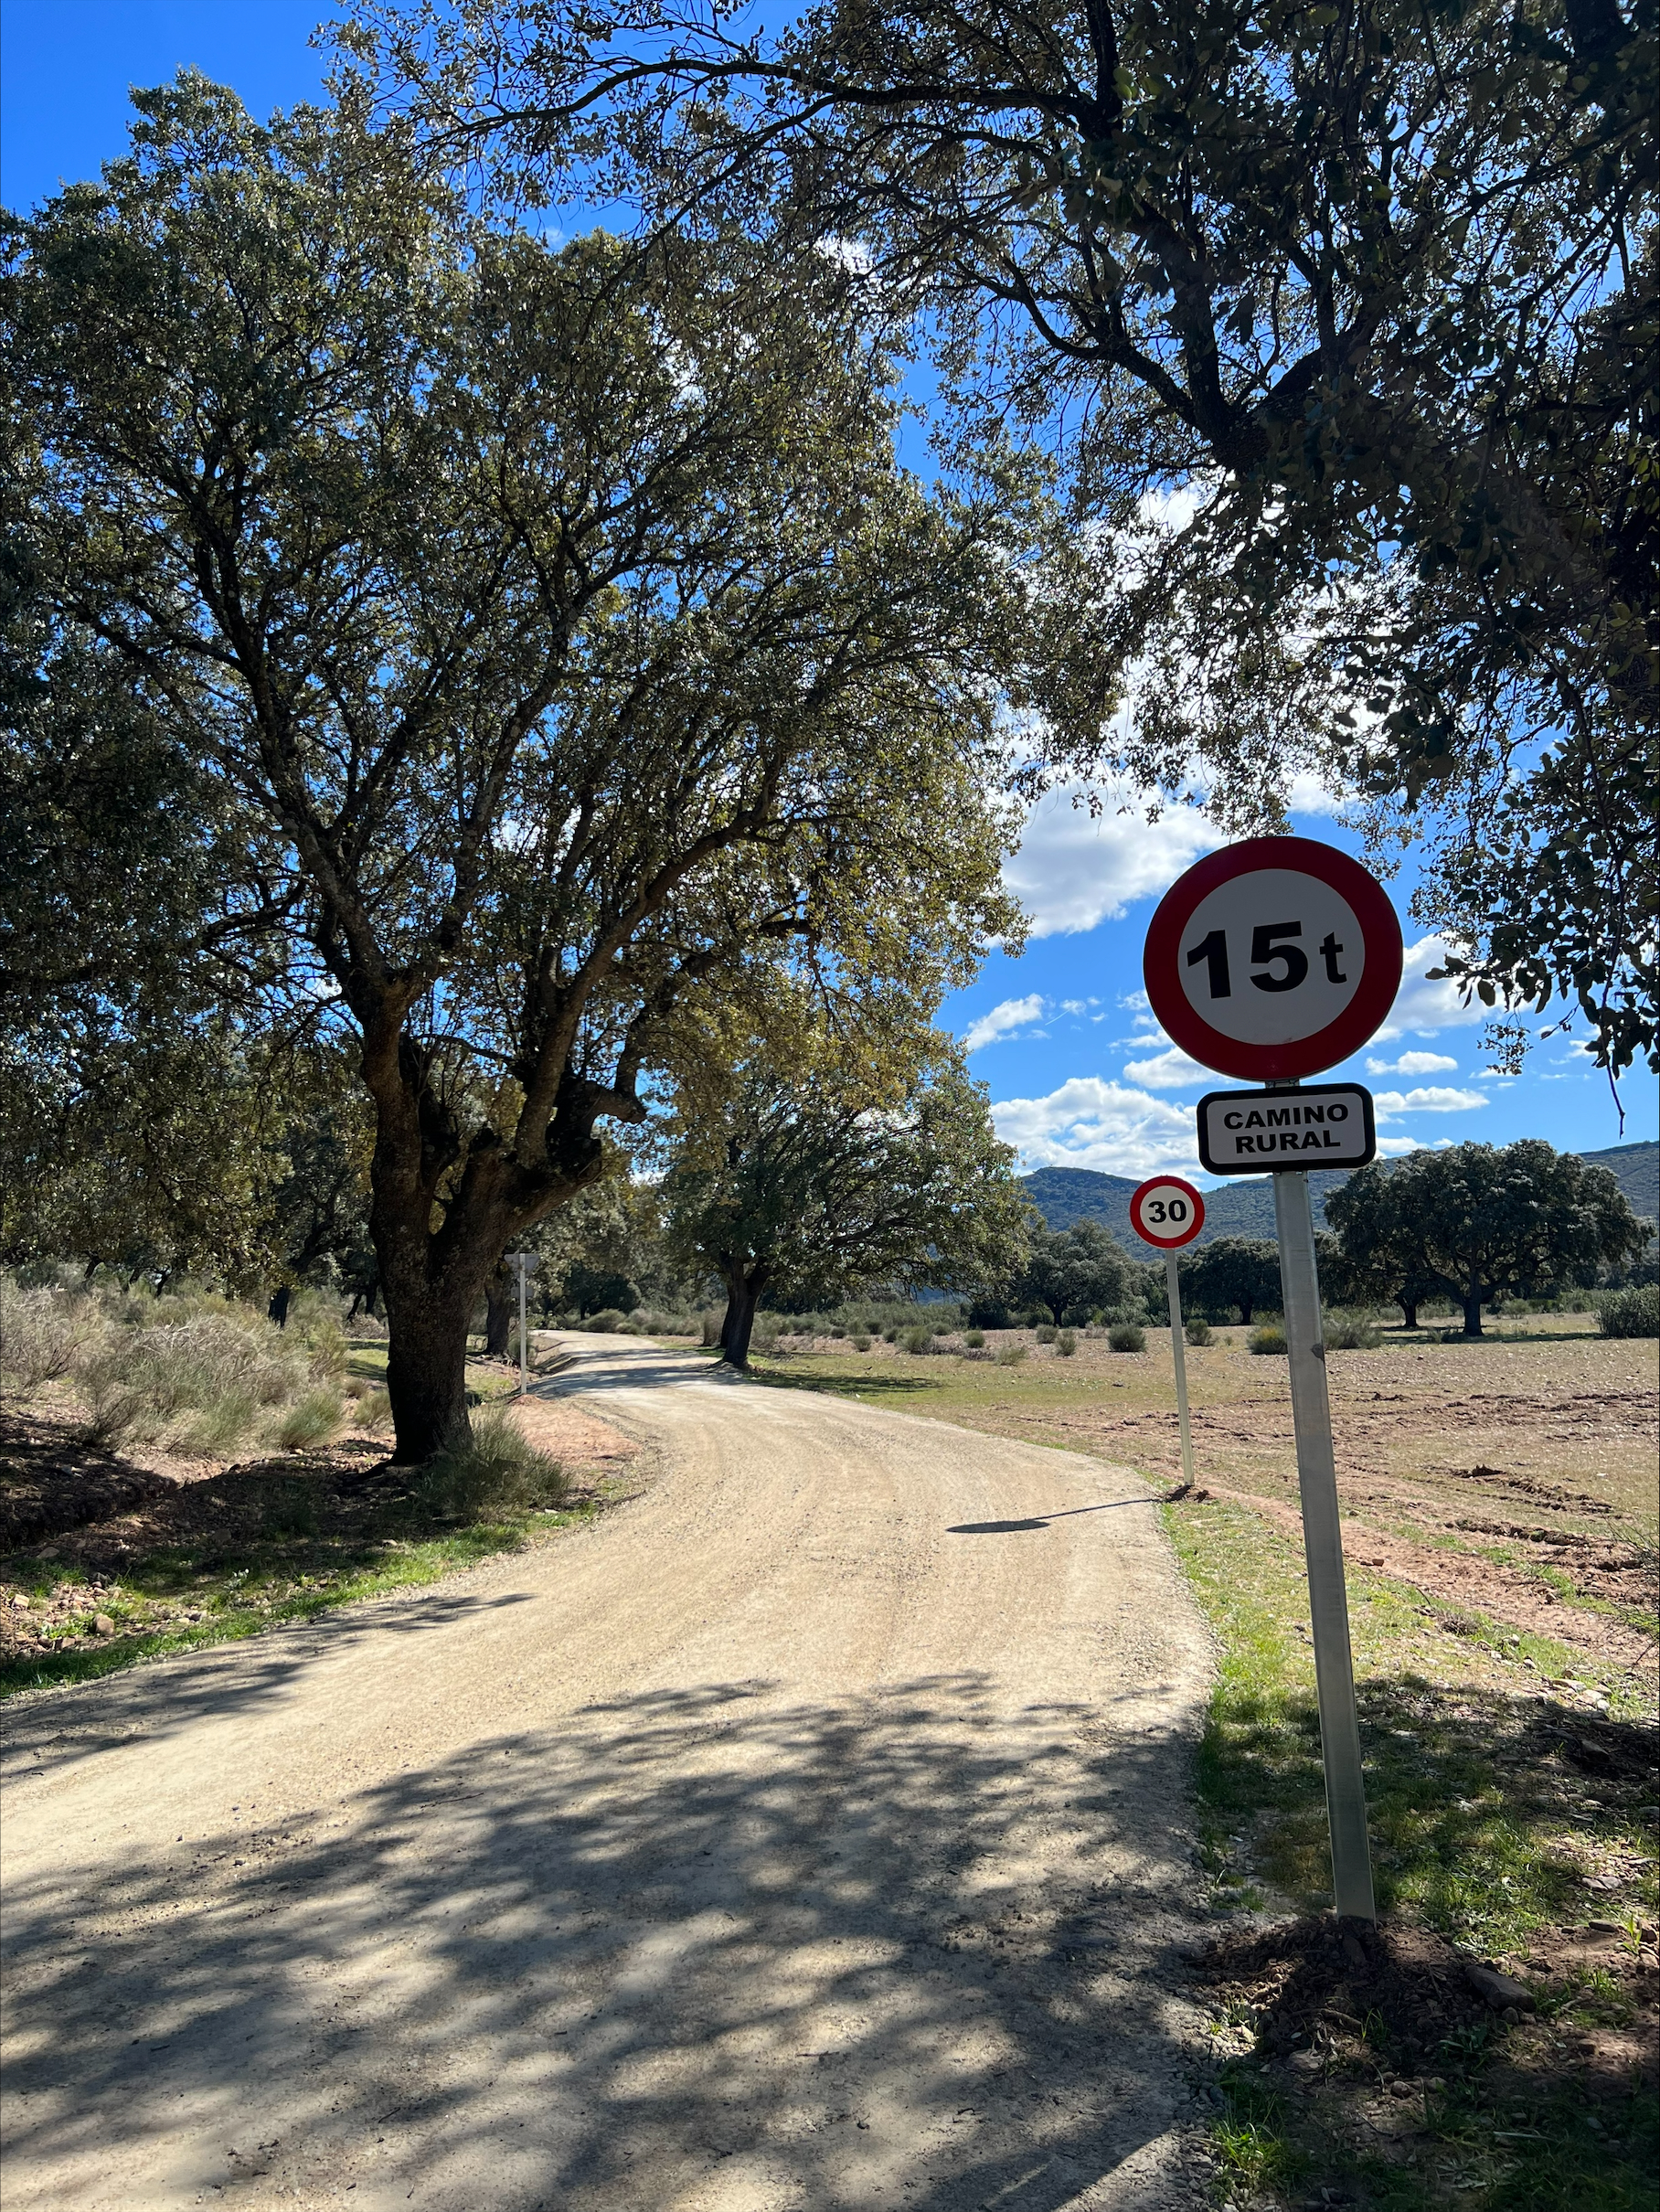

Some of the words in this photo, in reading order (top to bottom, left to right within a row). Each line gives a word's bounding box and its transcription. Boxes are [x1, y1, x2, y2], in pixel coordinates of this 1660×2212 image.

[1223, 1103, 1349, 1130] CAMINO
[1235, 1130, 1341, 1154] RURAL
[1147, 1199, 1187, 1223] 30
